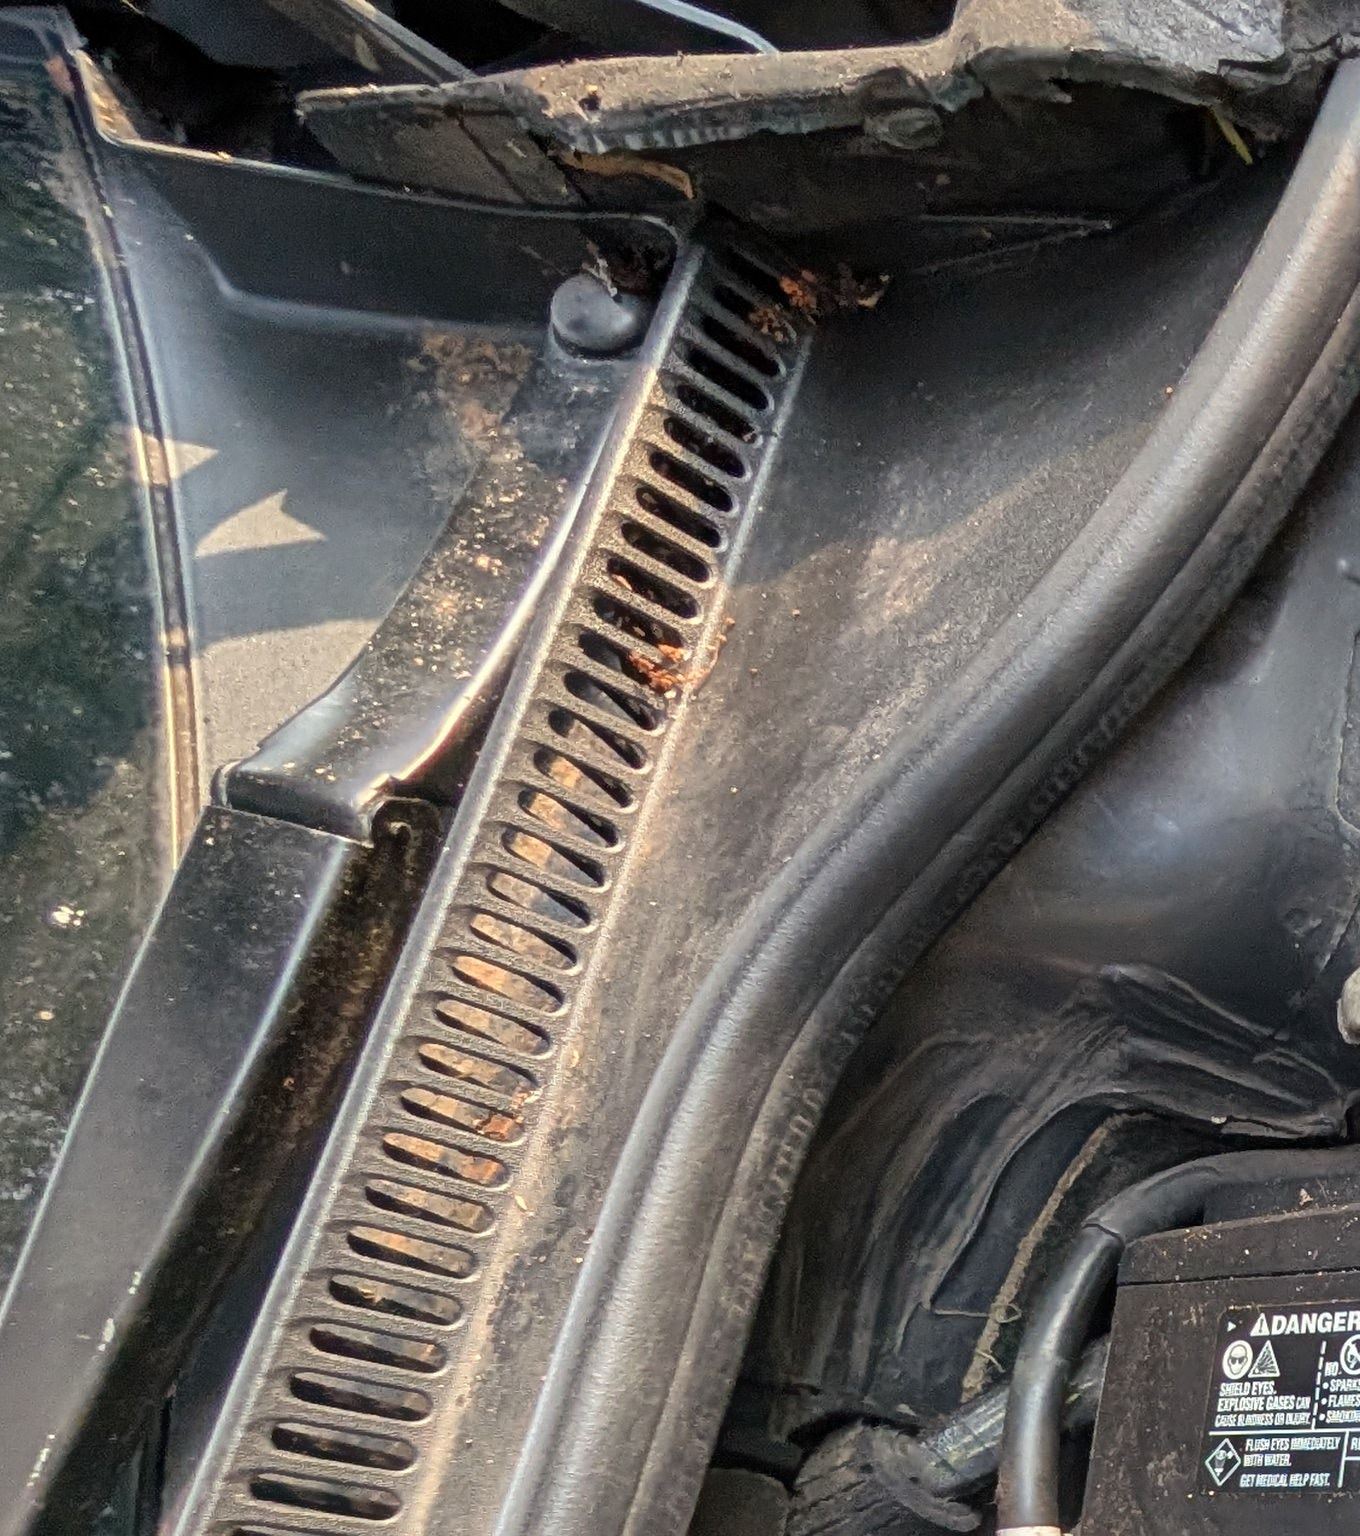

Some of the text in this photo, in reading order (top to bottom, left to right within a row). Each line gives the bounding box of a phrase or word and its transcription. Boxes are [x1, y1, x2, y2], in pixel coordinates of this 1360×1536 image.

[1220, 1381, 1277, 1396] SHIELD EYES.
[1217, 1397, 1265, 1412] EXPLOSIVE
[1266, 1395, 1295, 1410] GASES
[1271, 1439, 1289, 1450] EYES
[1240, 1474, 1256, 1487] GET
[1289, 1473, 1309, 1487] HELP
[1309, 1473, 1330, 1486] FAST.
